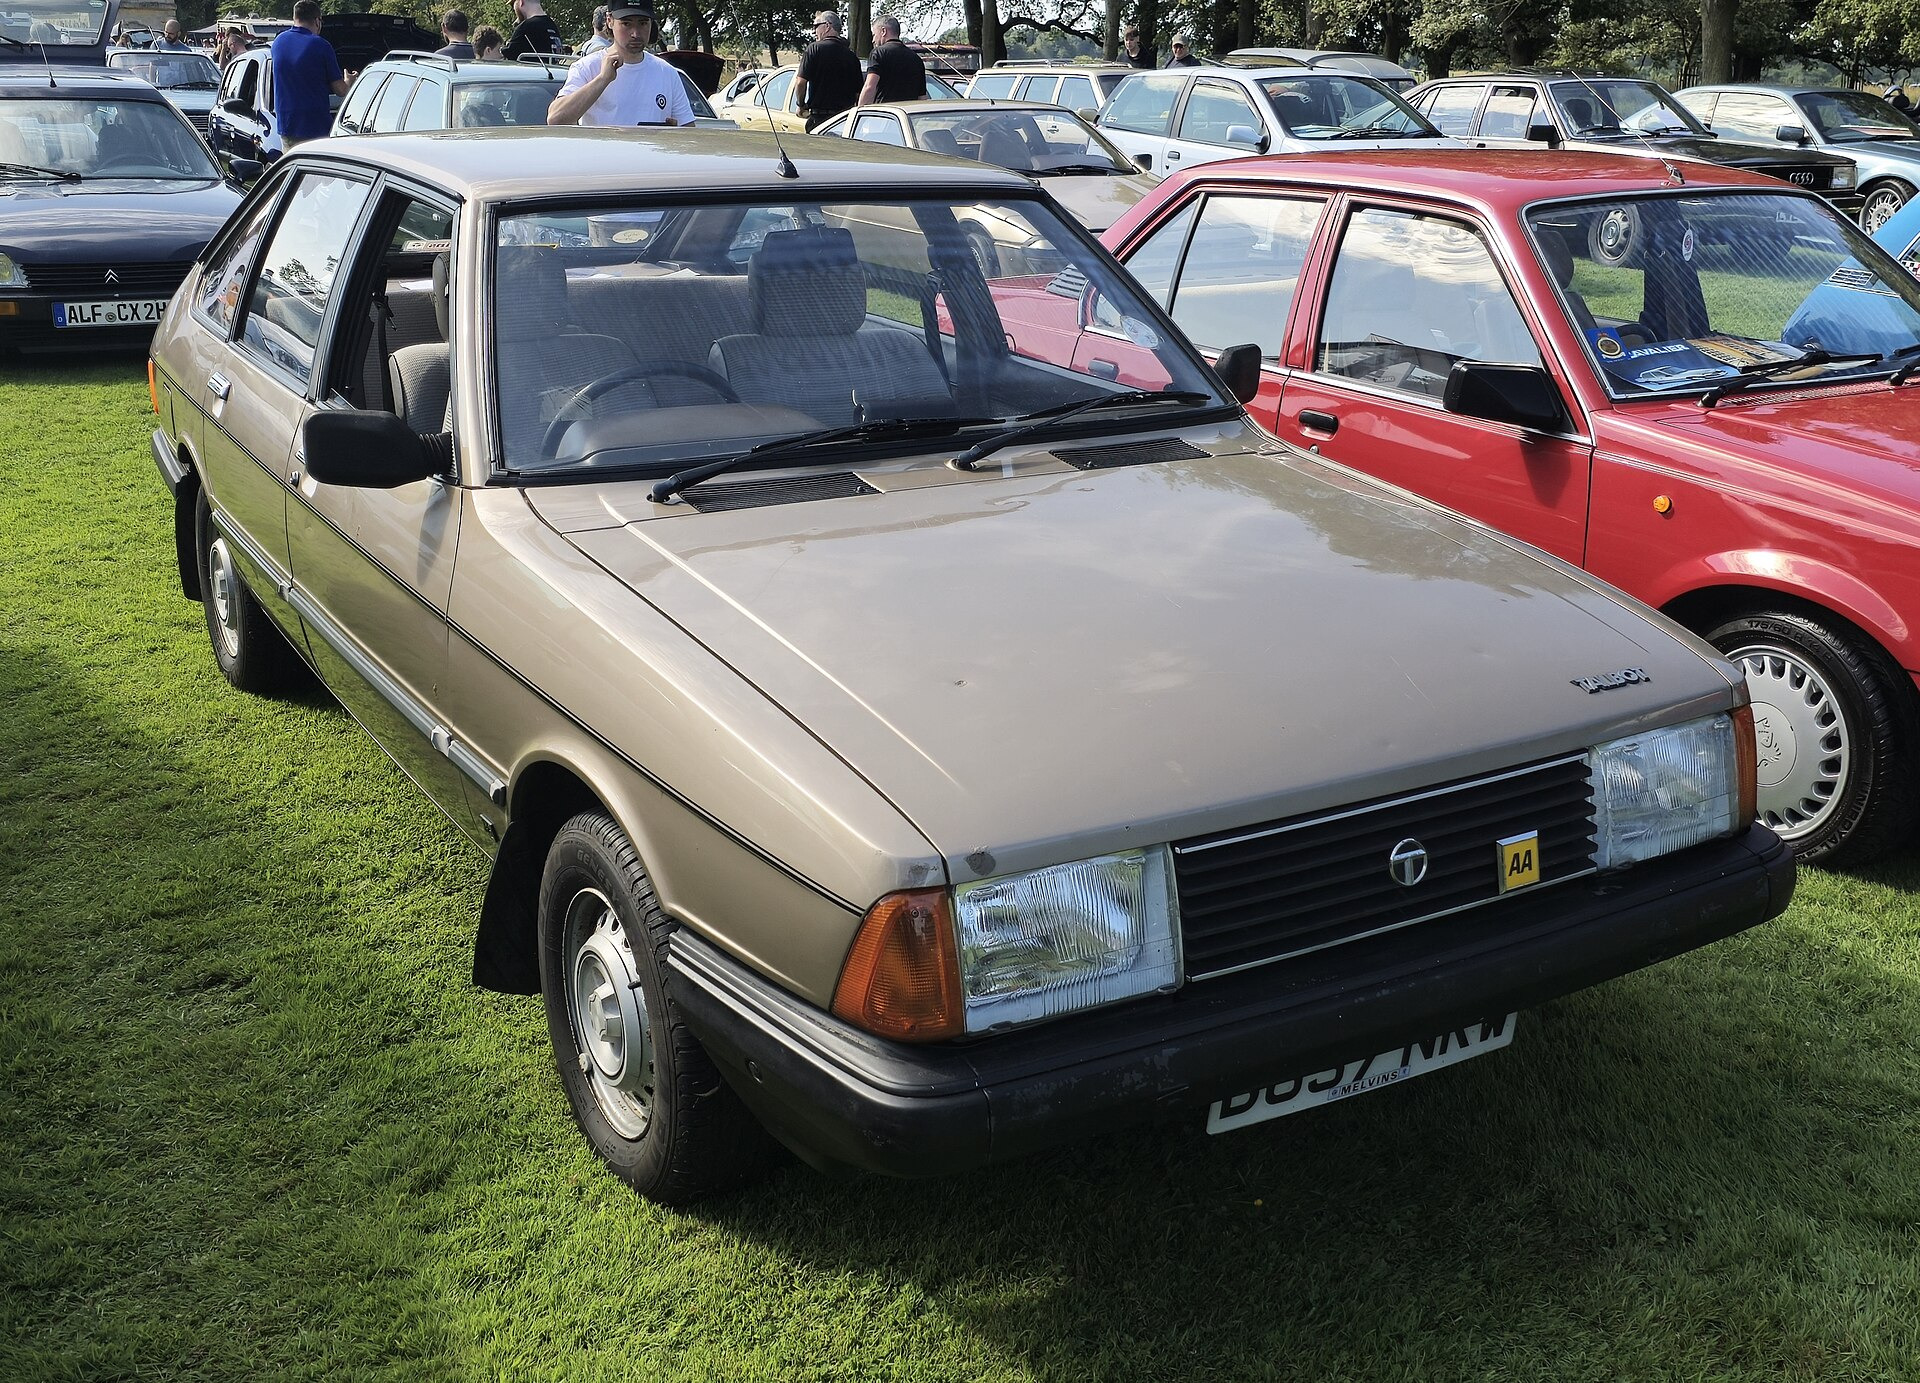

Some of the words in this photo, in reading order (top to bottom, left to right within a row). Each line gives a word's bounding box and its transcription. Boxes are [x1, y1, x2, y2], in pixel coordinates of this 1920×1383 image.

[68, 304, 102, 324] ALF
[117, 303, 141, 322] CX
[1569, 666, 1651, 694] TALBOT
[1508, 849, 1533, 877] AA
[1340, 1071, 1399, 1095] MELVINS
